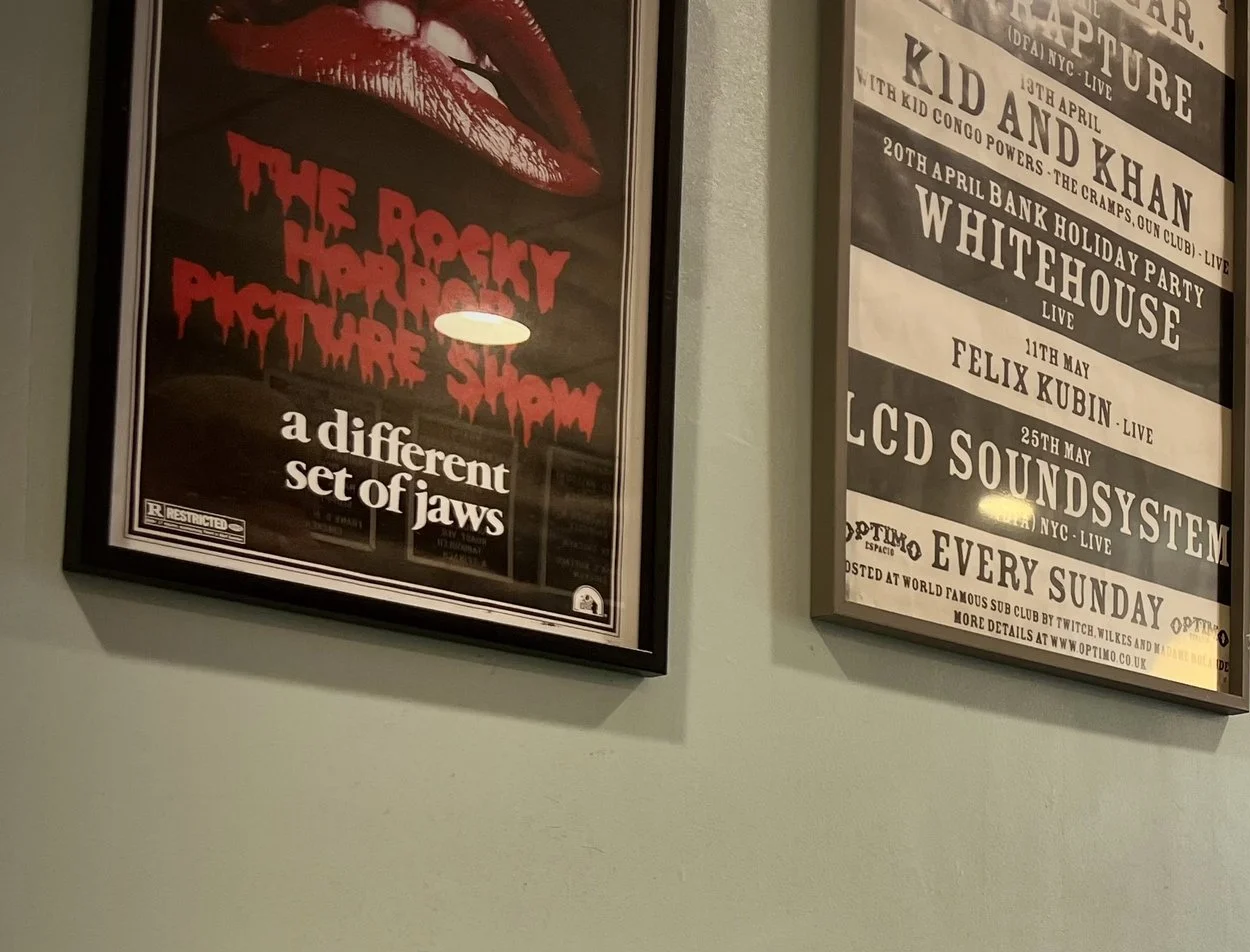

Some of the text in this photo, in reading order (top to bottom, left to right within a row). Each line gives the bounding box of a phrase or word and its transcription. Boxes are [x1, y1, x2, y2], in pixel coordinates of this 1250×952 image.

[1008, 25, 1112, 101] (DFA) NYC LIVE
[1020, 73, 1102, 134] 13TH APRIL
[902, 32, 1193, 233] KID AND KHAN
[226, 130, 571, 315] THE ROCKY
[883, 136, 1205, 309] 20TH APRIL BANK HOLIDAY PARTY
[900, 90, 928, 118] KID
[932, 107, 983, 145] CONGO
[985, 133, 1044, 176] POWERS
[1053, 168, 1078, 195] THE
[1081, 184, 1135, 227] CRAMPS,
[1137, 214, 1160, 239] GUN
[1163, 229, 1196, 259] CLUB)
[1204, 250, 1230, 275] LIVE
[915, 184, 1181, 351] WHITEHOUSE
[172, 256, 602, 448] PICTURE SHOW
[1042, 301, 1075, 331] LIVE
[951, 336, 1154, 445] FELIX KUBIN LIVE
[1025, 338, 1091, 380] 11TH MAY
[279, 408, 511, 494] a different
[846, 390, 1230, 568] LCD SOUNDSYSTEM
[1020, 426, 1092, 467] 25TH MAY
[147, 502, 164, 518] R
[166, 507, 228, 531] RESTRICTED
[285, 459, 353, 502] set
[358, 472, 413, 514] of
[411, 479, 505, 537] jaws
[1040, 517, 1069, 542] NYC
[1080, 527, 1112, 556] LIVE
[886, 569, 900, 586] AT
[902, 574, 943, 597] WORLD
[946, 587, 988, 609] FAMOUS
[990, 598, 1011, 615] SUB
[1014, 605, 1039, 624] CLUB
[1042, 611, 1053, 627] BY
[1098, 626, 1132, 647] WILKES
[1134, 637, 1152, 652] AND
[931, 529, 1164, 631] EVERY SUNDAY
[953, 610, 985, 630] MORE
[987, 618, 1033, 642] DETAILS
[1036, 630, 1049, 646] AT
